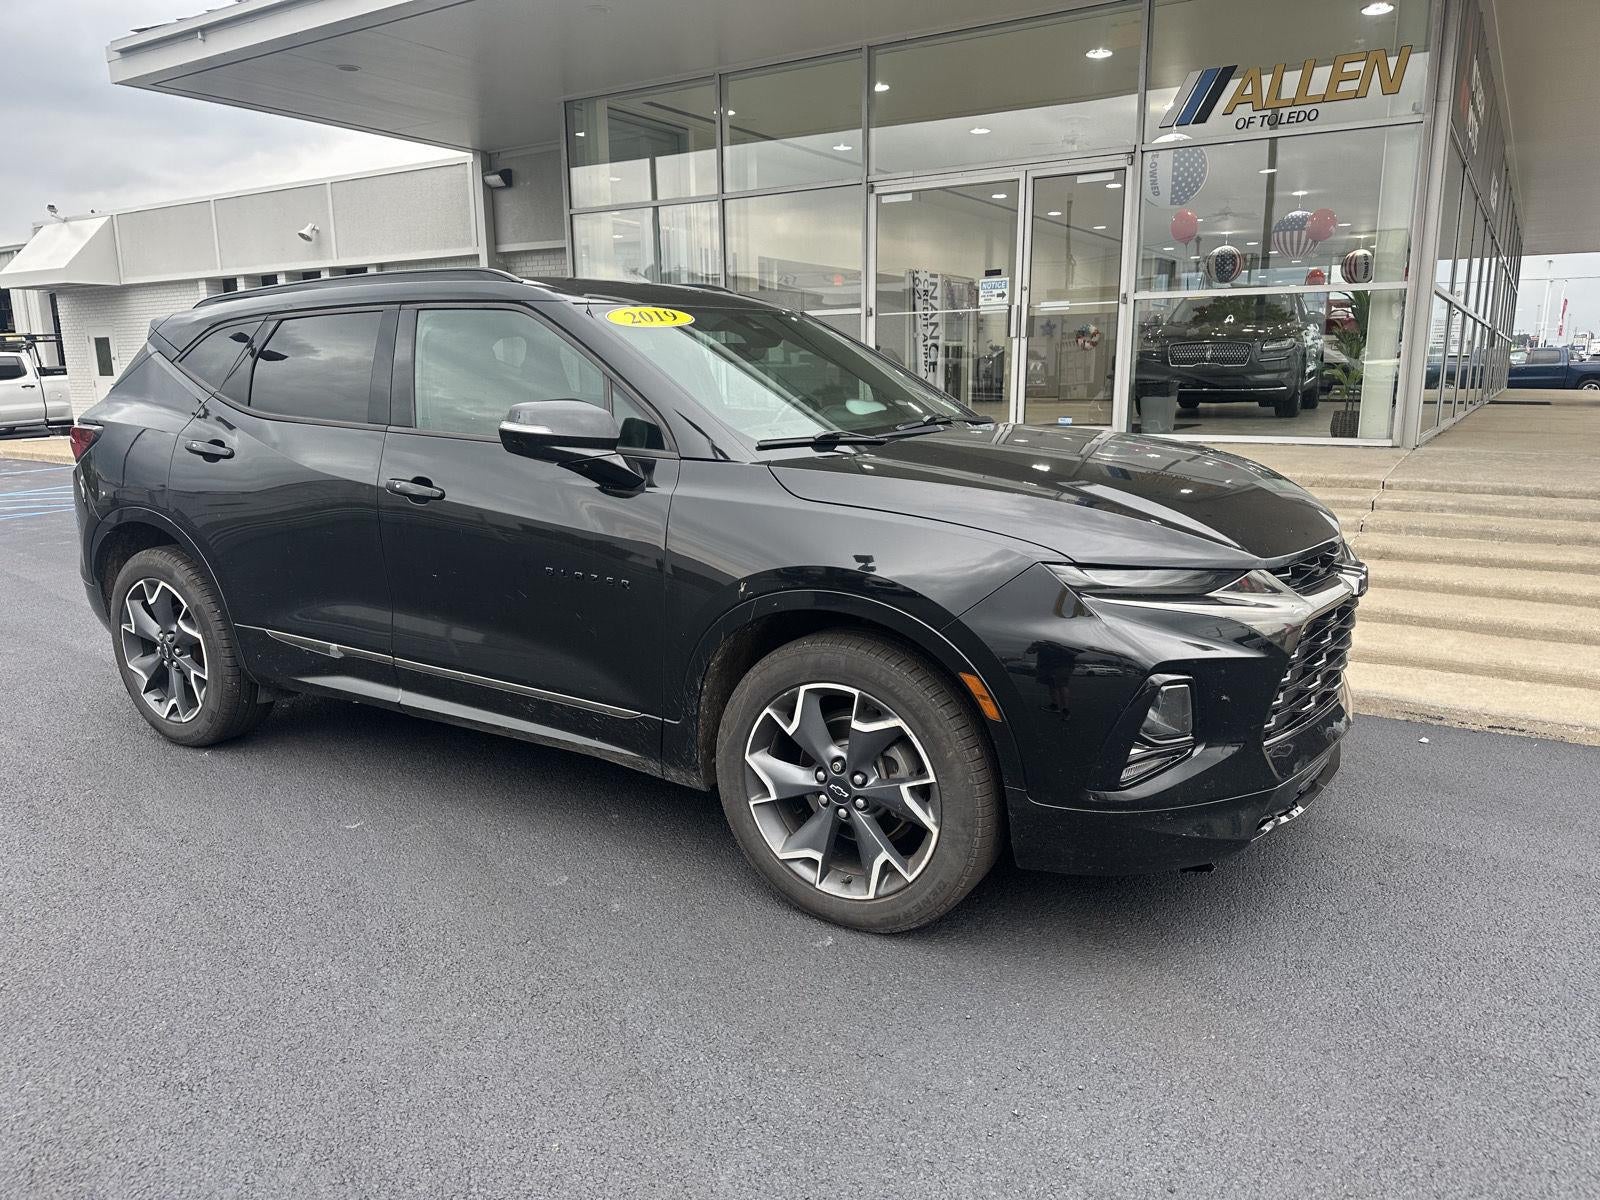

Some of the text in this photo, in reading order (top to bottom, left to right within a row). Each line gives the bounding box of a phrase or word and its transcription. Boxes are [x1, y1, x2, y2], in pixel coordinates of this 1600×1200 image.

[1222, 45, 1413, 115] ALLEN
[1234, 108, 1320, 130] OF TOLEDO
[982, 281, 1007, 290] NOTICE
[624, 311, 678, 324] 2019
